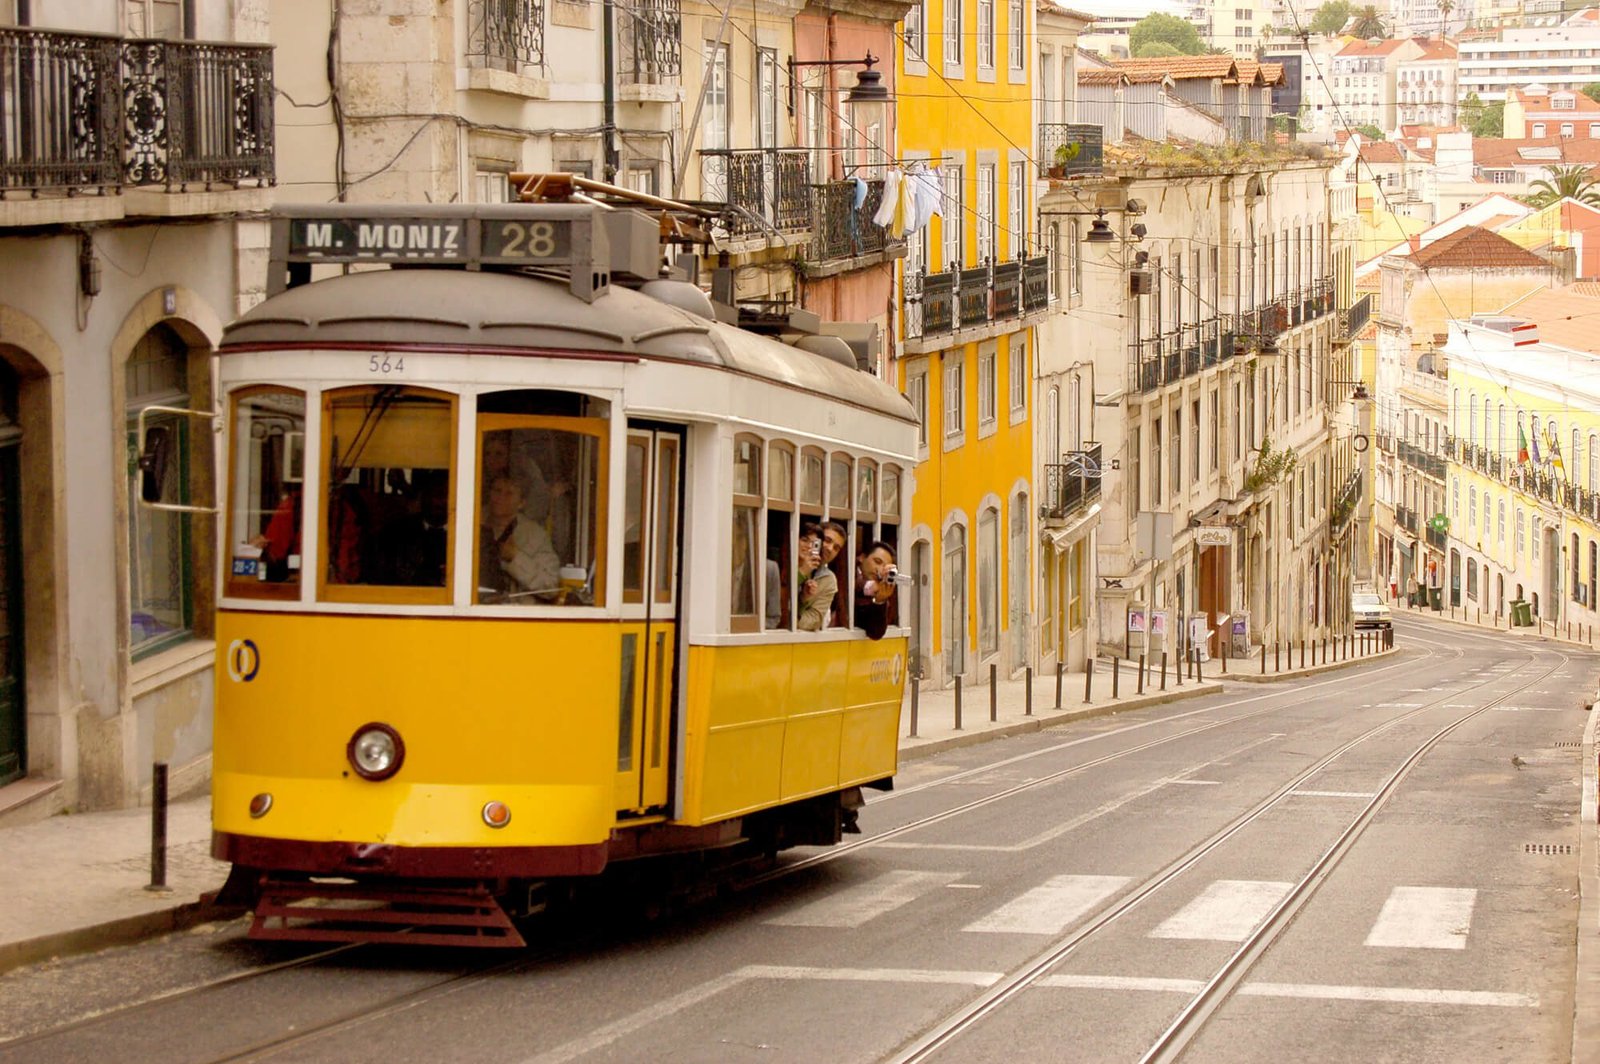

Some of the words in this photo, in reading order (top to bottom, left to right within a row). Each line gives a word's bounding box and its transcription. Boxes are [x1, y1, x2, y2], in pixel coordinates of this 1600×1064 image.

[306, 223, 344, 249] M.
[358, 224, 459, 250] MONIZ
[501, 222, 556, 258] 28
[369, 354, 404, 374] 564
